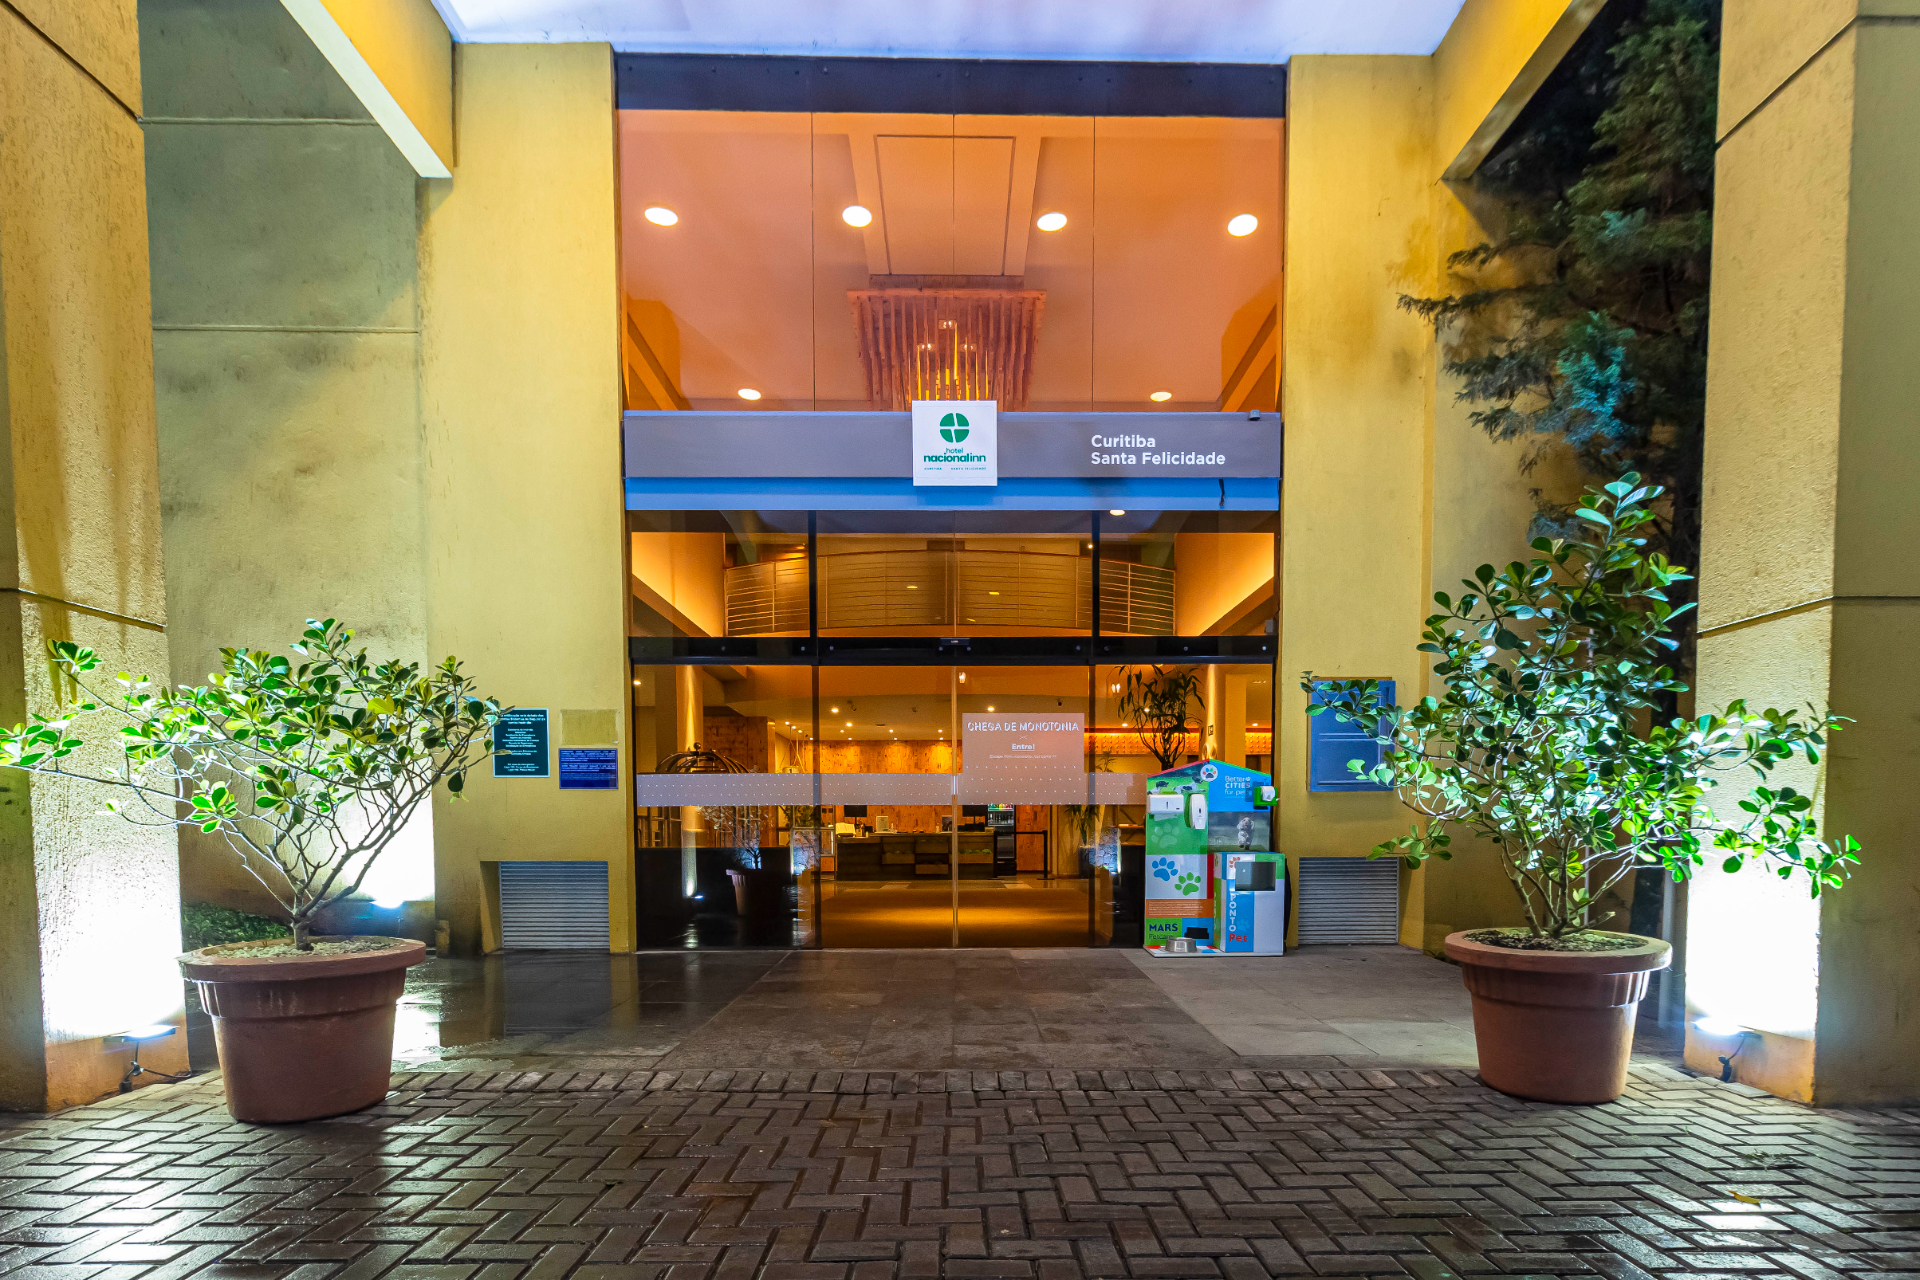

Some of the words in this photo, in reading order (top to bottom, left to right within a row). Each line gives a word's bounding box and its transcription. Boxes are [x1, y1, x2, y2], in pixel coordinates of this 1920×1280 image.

[1091, 434, 1156, 448] Curitiba
[923, 453, 987, 463] nacionalinn
[1091, 452, 1137, 466] Santa
[1142, 451, 1226, 466] Felicidade
[967, 721, 1002, 732] CHEGA
[1004, 721, 1017, 732] DE
[1019, 721, 1080, 732] MONOTONIA
[1228, 892, 1237, 932] PONTO
[1148, 923, 1179, 932] MARS
[1228, 933, 1248, 943] Pet
